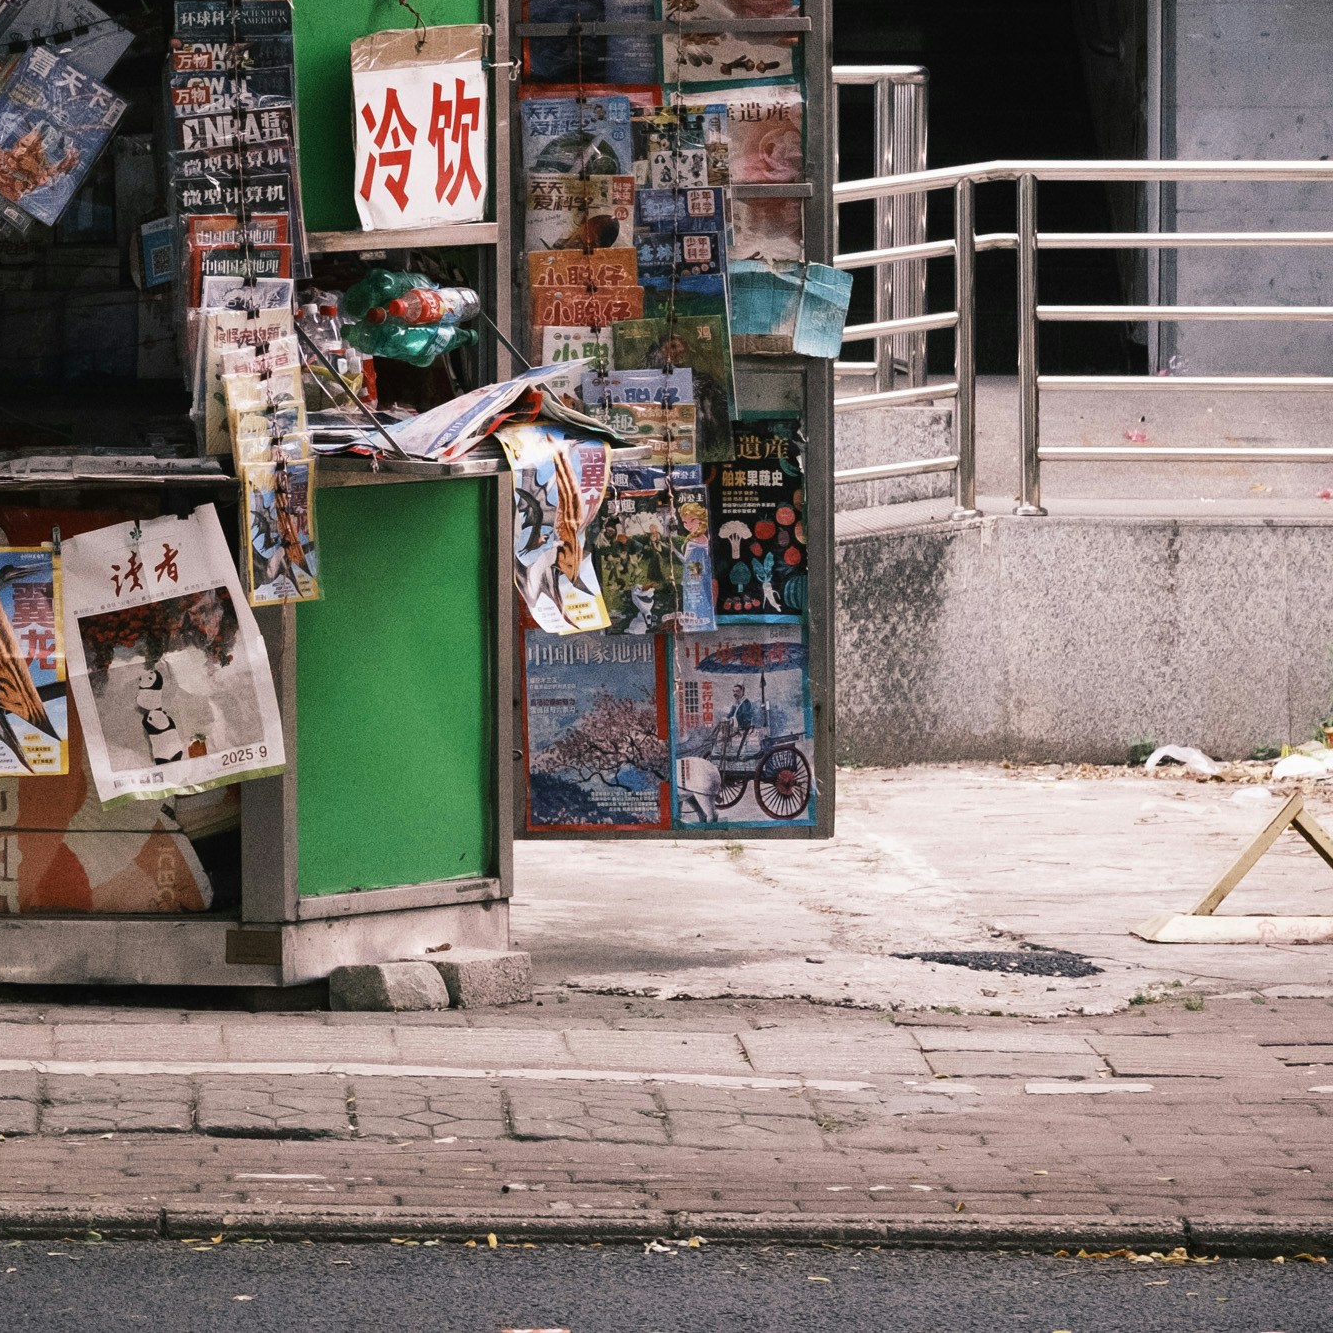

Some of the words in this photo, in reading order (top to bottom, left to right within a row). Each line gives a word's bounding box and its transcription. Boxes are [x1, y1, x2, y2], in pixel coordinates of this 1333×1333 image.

[180, 10, 241, 26] 环球科学
[178, 54, 210, 69] 万物
[27, 45, 113, 108] 看天下
[176, 89, 206, 104] 万物
[360, 78, 482, 213] 冷饮
[183, 148, 286, 177] 微型计算机
[182, 184, 286, 207] 微型计算机
[531, 181, 563, 194] 天天
[678, 493, 704, 503] 小公主
[110, 543, 179, 597] 读者
[12, 582, 57, 670] 翼龙
[528, 642, 653, 666] 中国国家地理
